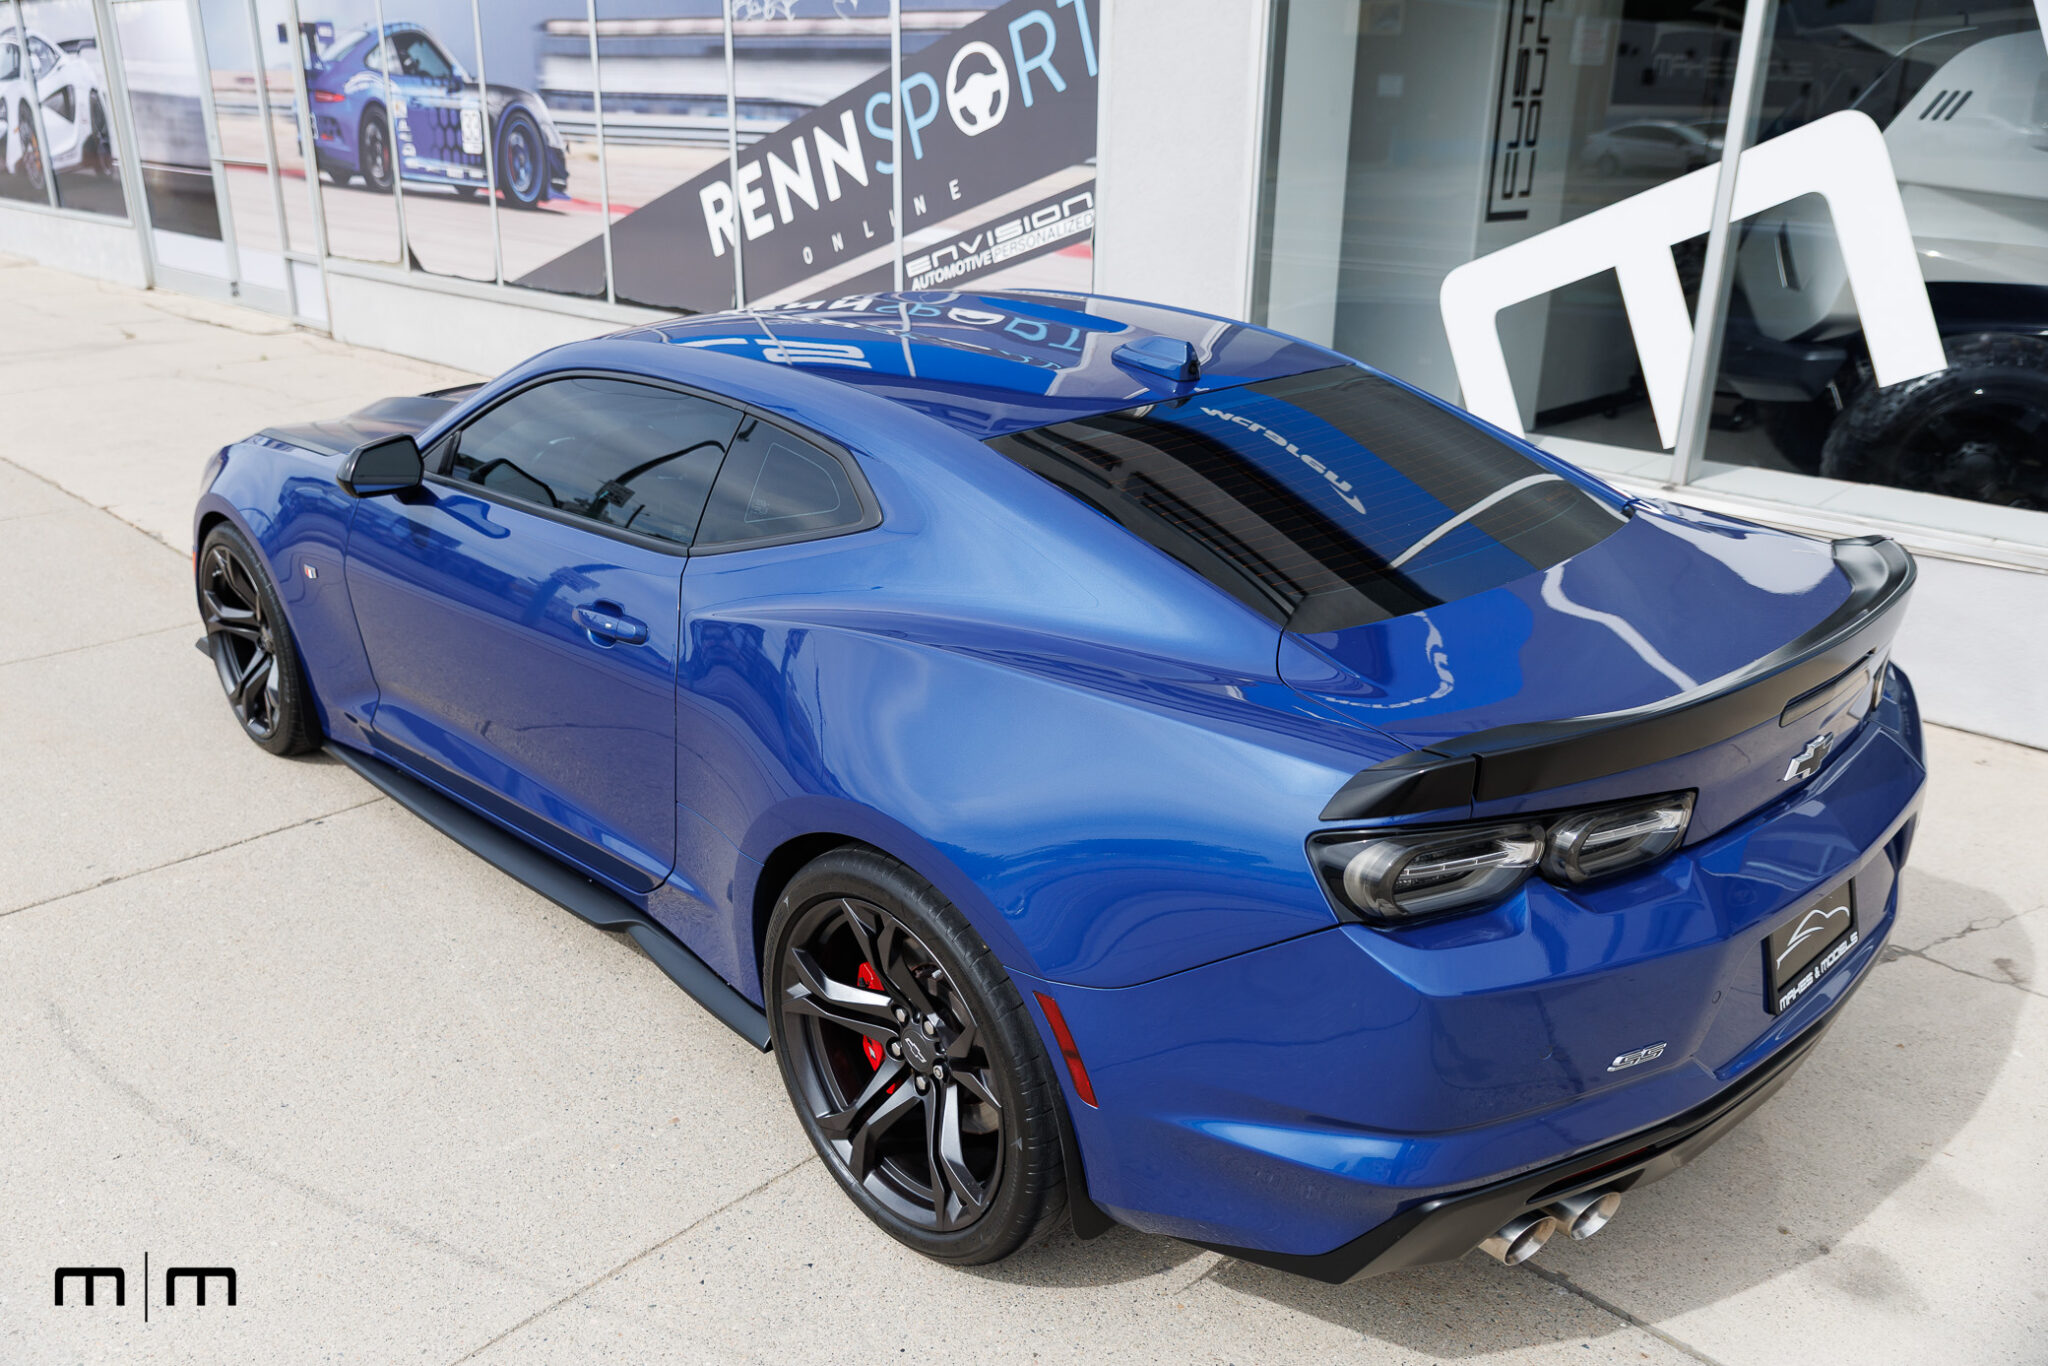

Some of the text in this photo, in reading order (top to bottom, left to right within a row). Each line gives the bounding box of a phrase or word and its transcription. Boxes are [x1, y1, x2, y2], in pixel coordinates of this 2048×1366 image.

[1779, 931, 1859, 1012] MAKES & MODELS
[1606, 1041, 1668, 1073] SS
